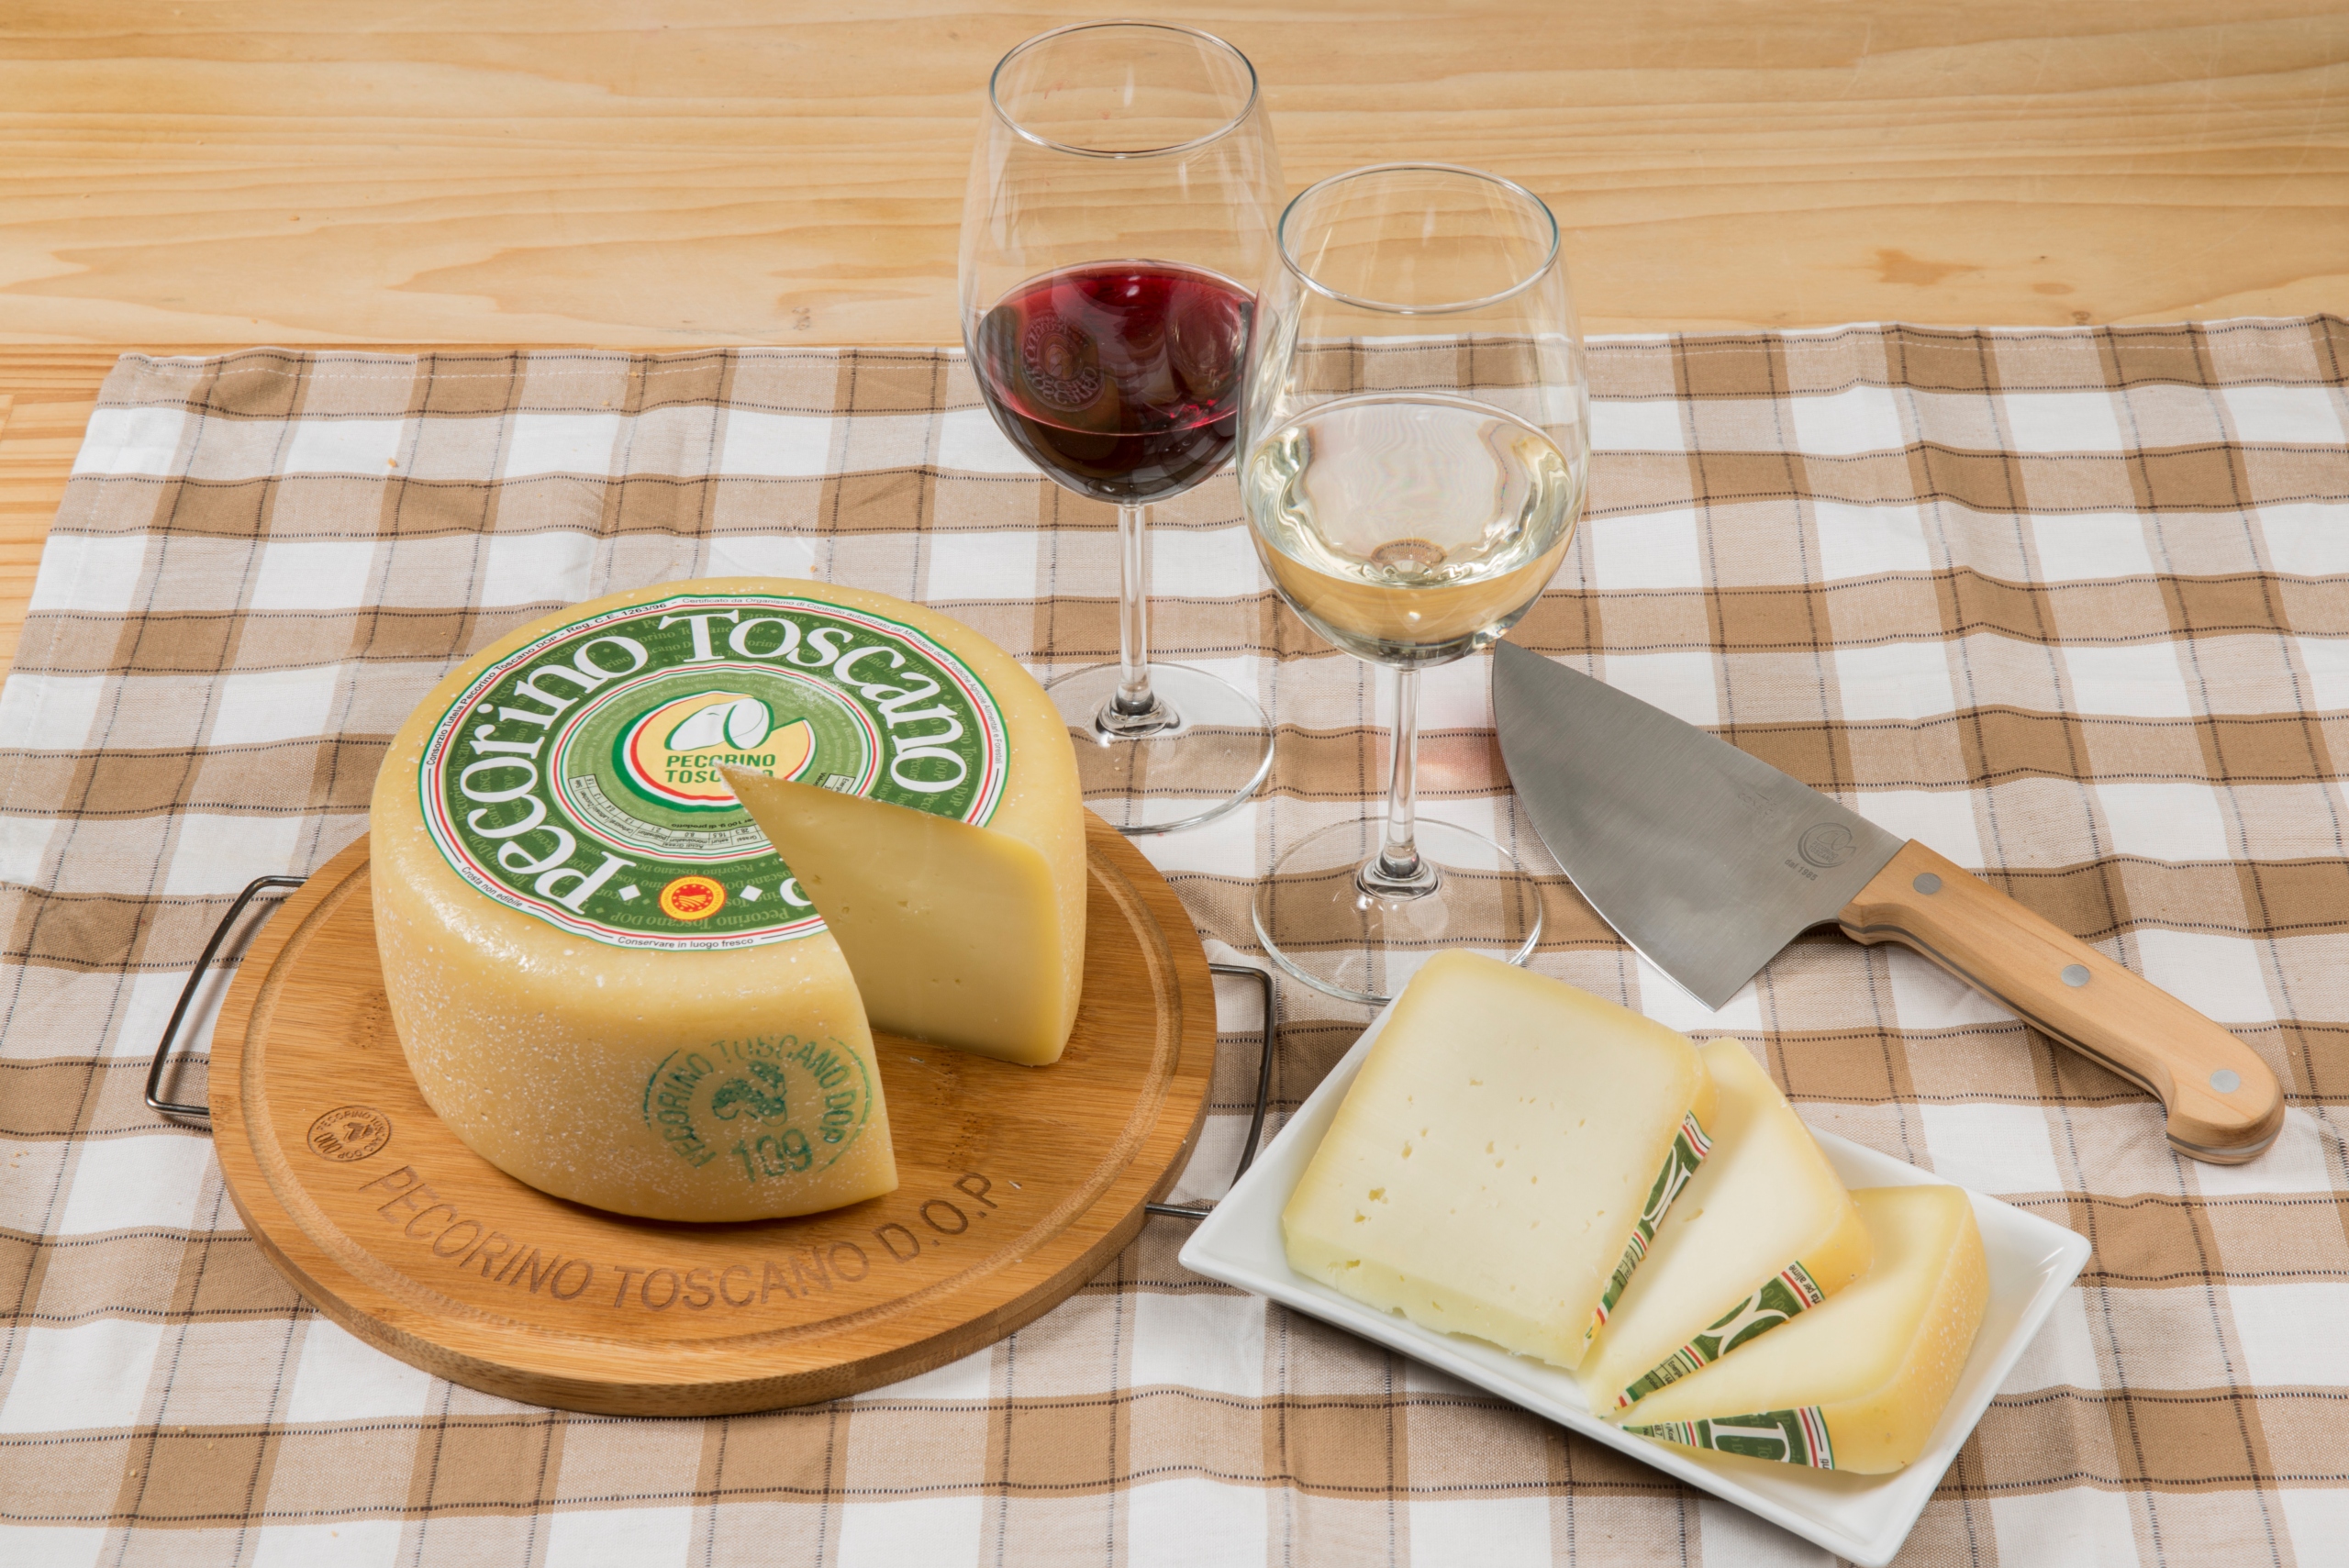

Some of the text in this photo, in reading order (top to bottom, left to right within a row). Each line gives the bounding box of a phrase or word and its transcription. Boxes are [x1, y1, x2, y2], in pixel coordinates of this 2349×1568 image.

[426, 603, 666, 766] Consorzio Tutela Pecorino Toscano DOP Reg. C.E. 1263/96
[745, 597, 795, 606] Organismo
[807, 603, 845, 616] Controllo
[846, 612, 890, 630] autorizzato
[891, 623, 904, 634] dal
[903, 629, 934, 652] Ministero
[934, 649, 951, 662] delle
[948, 661, 971, 684] Politiche
[968, 681, 986, 707] Agricole
[984, 704, 999, 735] Alimentari
[994, 738, 1003, 764] Forestali
[460, 609, 967, 915] Pecorino Toscano
[666, 754, 776, 768] PECORINO
[462, 866, 523, 907] Crosta non edibile
[1784, 858, 1819, 881] dal 1985
[618, 936, 753, 950] Conservare in luogo fresco
[717, 907, 790, 928] Pecorino
[711, 1034, 852, 1089] TOSCANO
[818, 1089, 858, 1144] DOP
[731, 1129, 813, 1183] 109
[360, 1164, 998, 1312] PECORINO TOSCANO D.O.P
